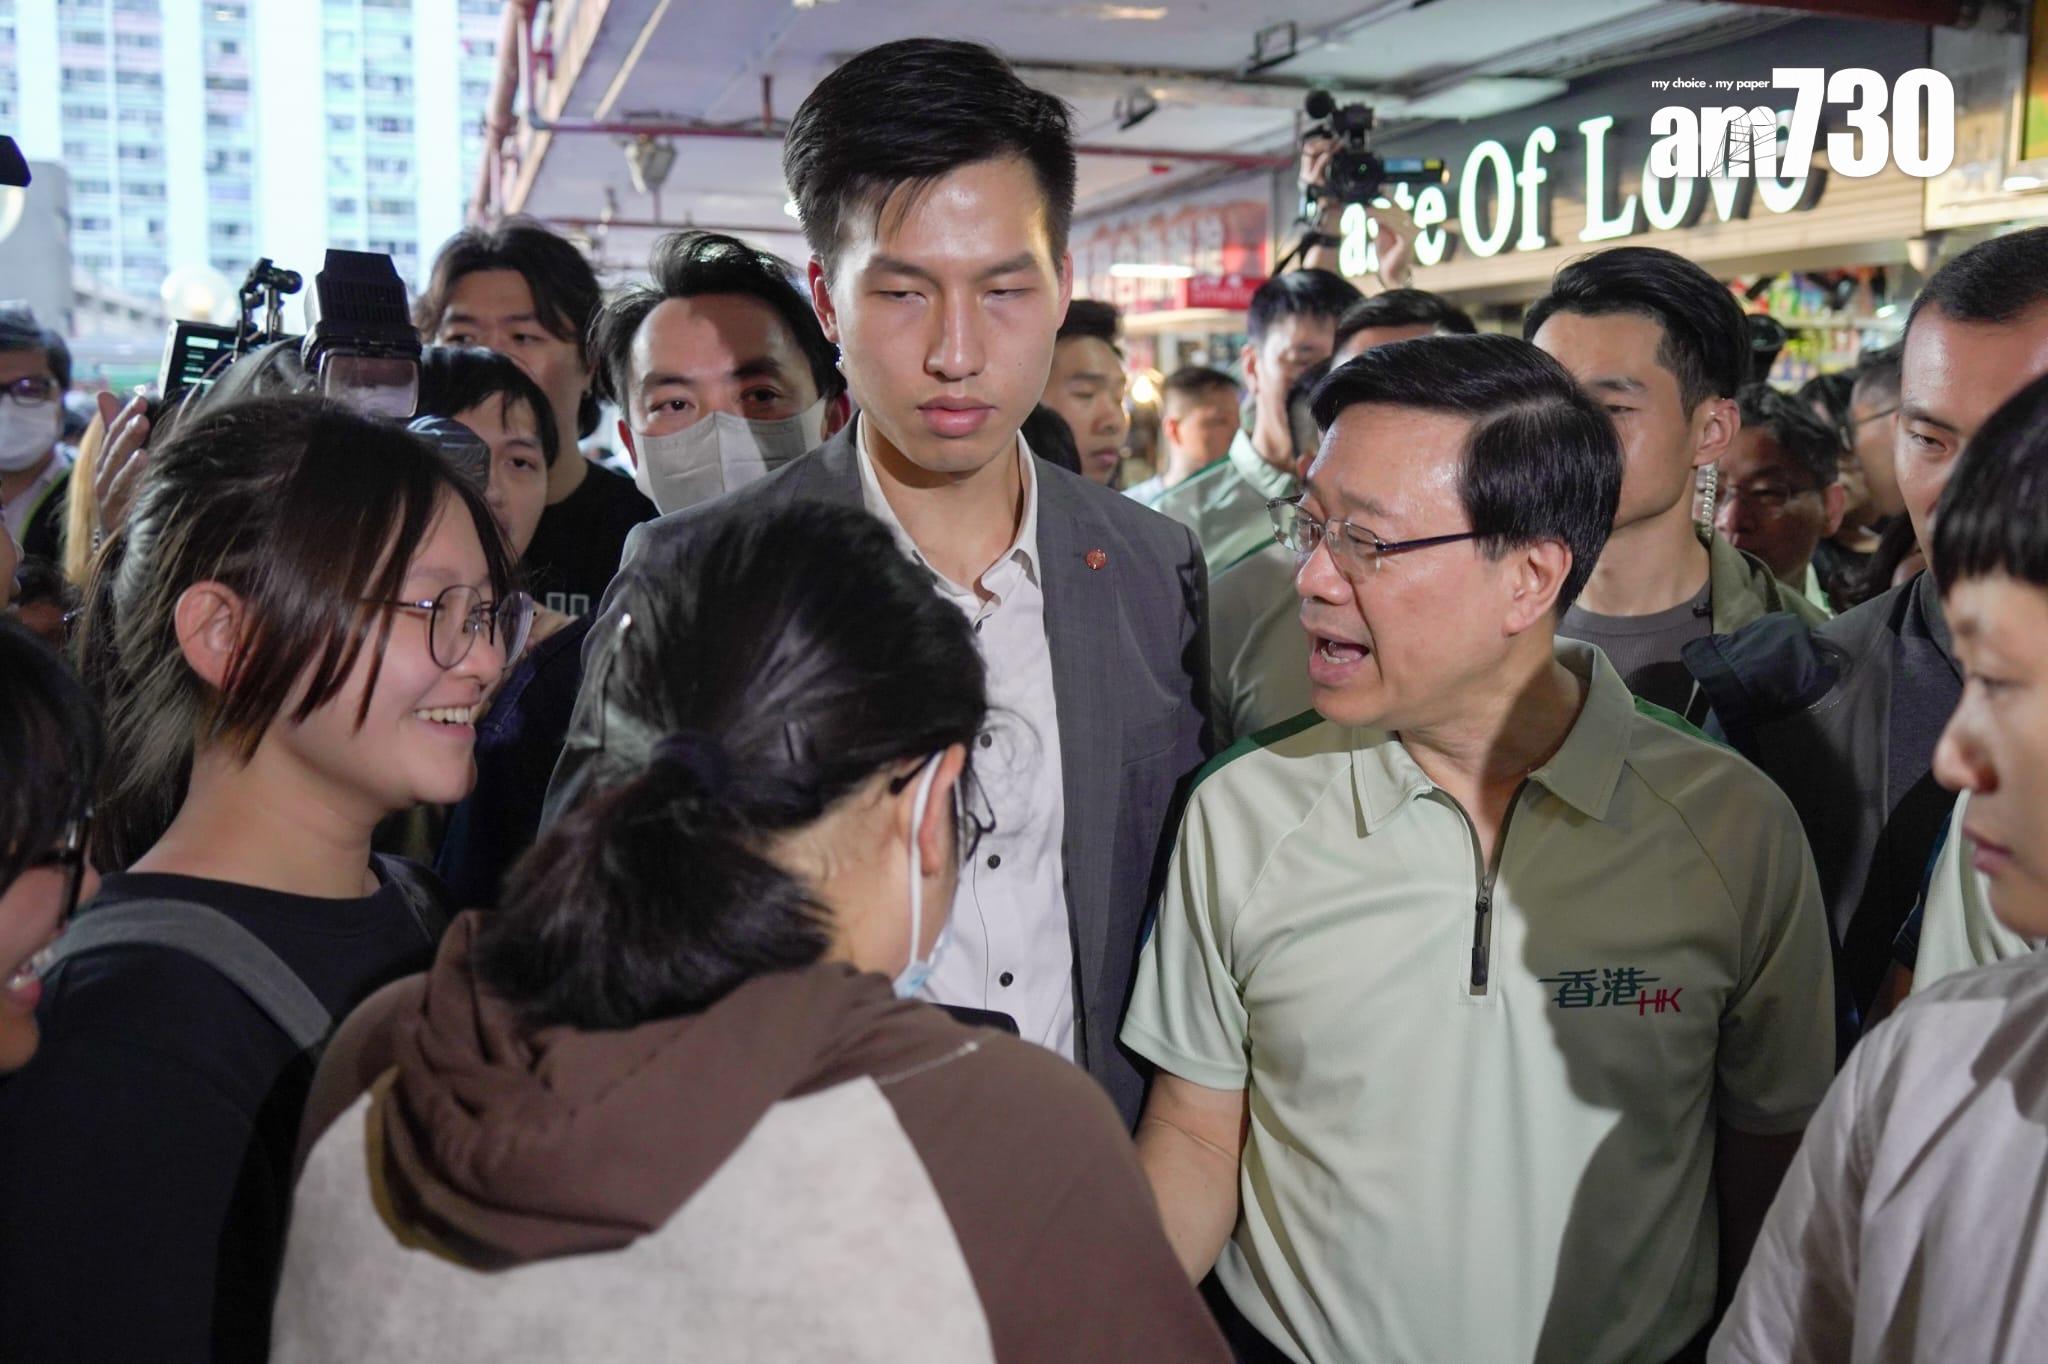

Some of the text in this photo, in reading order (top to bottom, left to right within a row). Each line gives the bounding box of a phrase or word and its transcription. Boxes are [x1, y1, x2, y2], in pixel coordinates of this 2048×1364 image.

[1459, 126, 1556, 257] Of
[1537, 967, 1661, 1008] 香港
[1639, 988, 1683, 1016] HK
